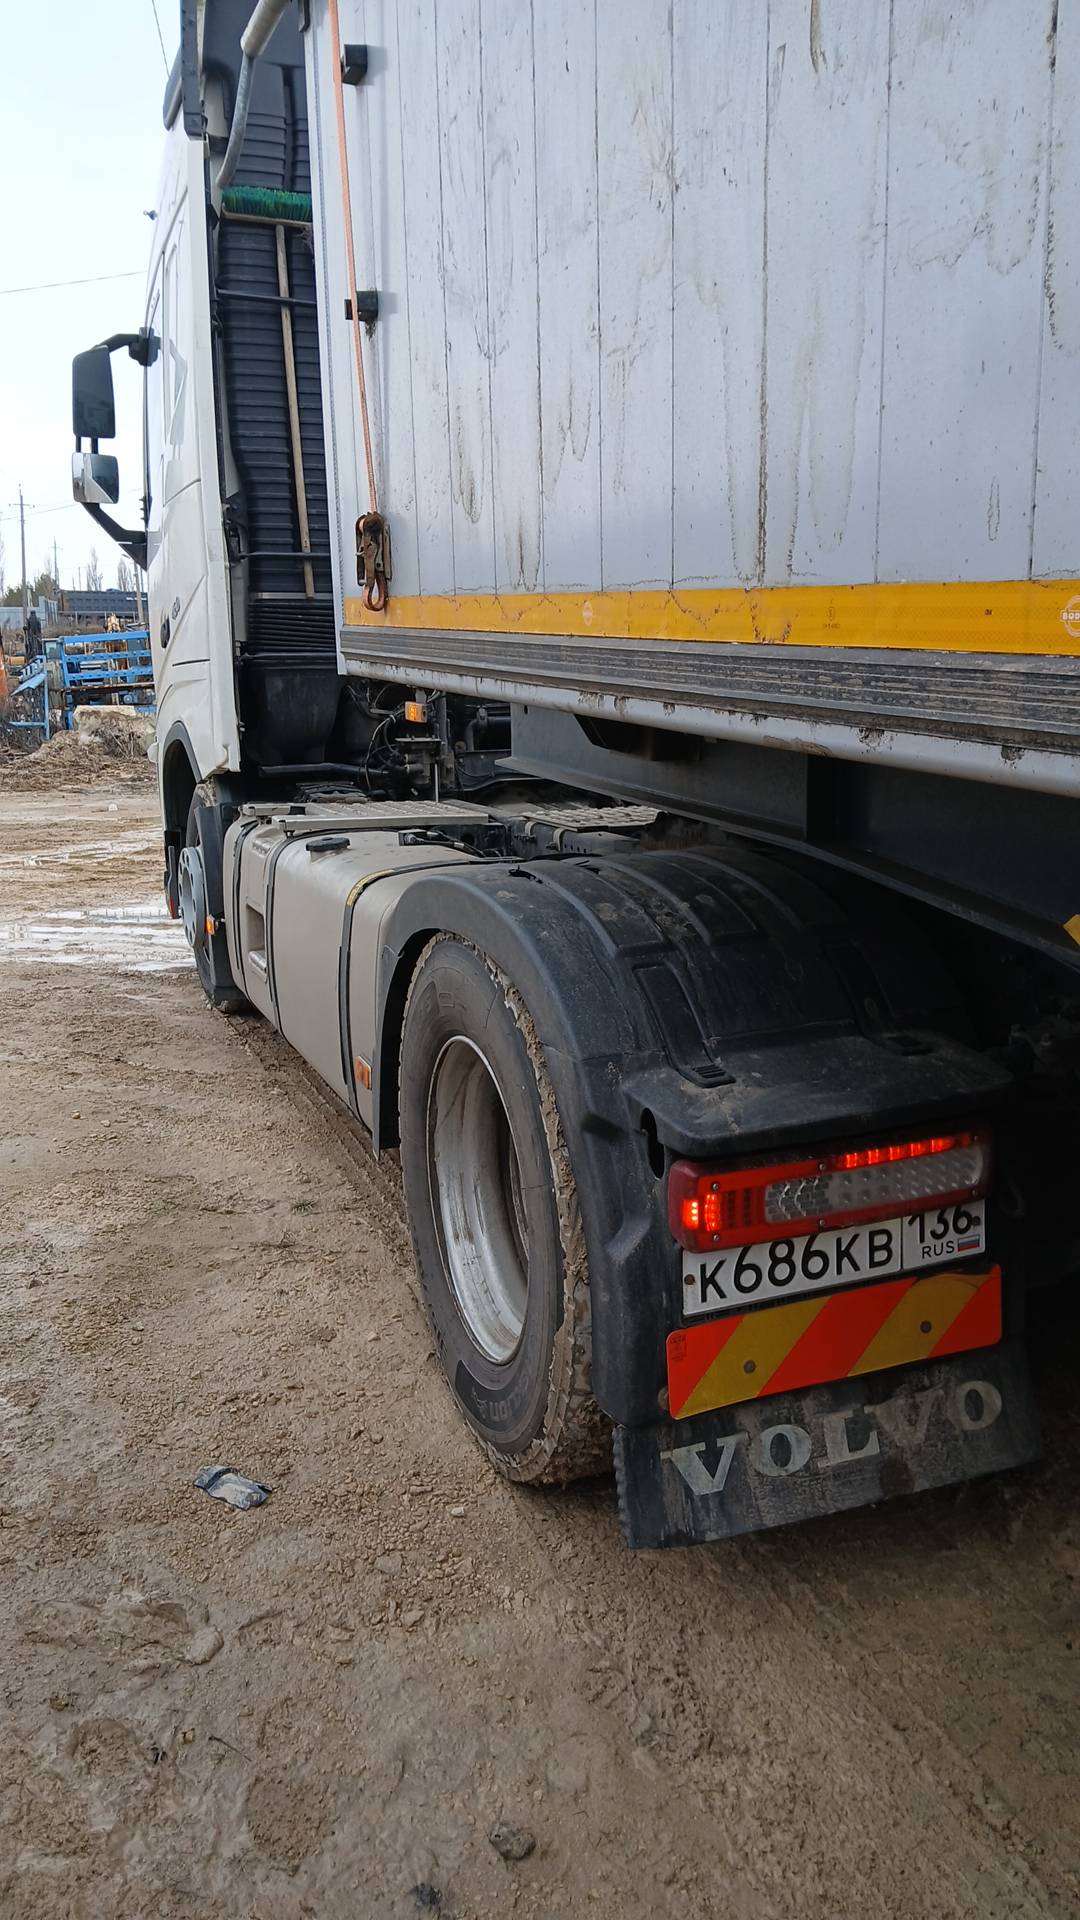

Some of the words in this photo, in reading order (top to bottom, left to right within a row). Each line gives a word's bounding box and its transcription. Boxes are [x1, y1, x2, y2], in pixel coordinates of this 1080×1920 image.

[908, 1206, 972, 1243] 136
[922, 1241, 955, 1259] RUS
[660, 1380, 1002, 1496] VOLVO
